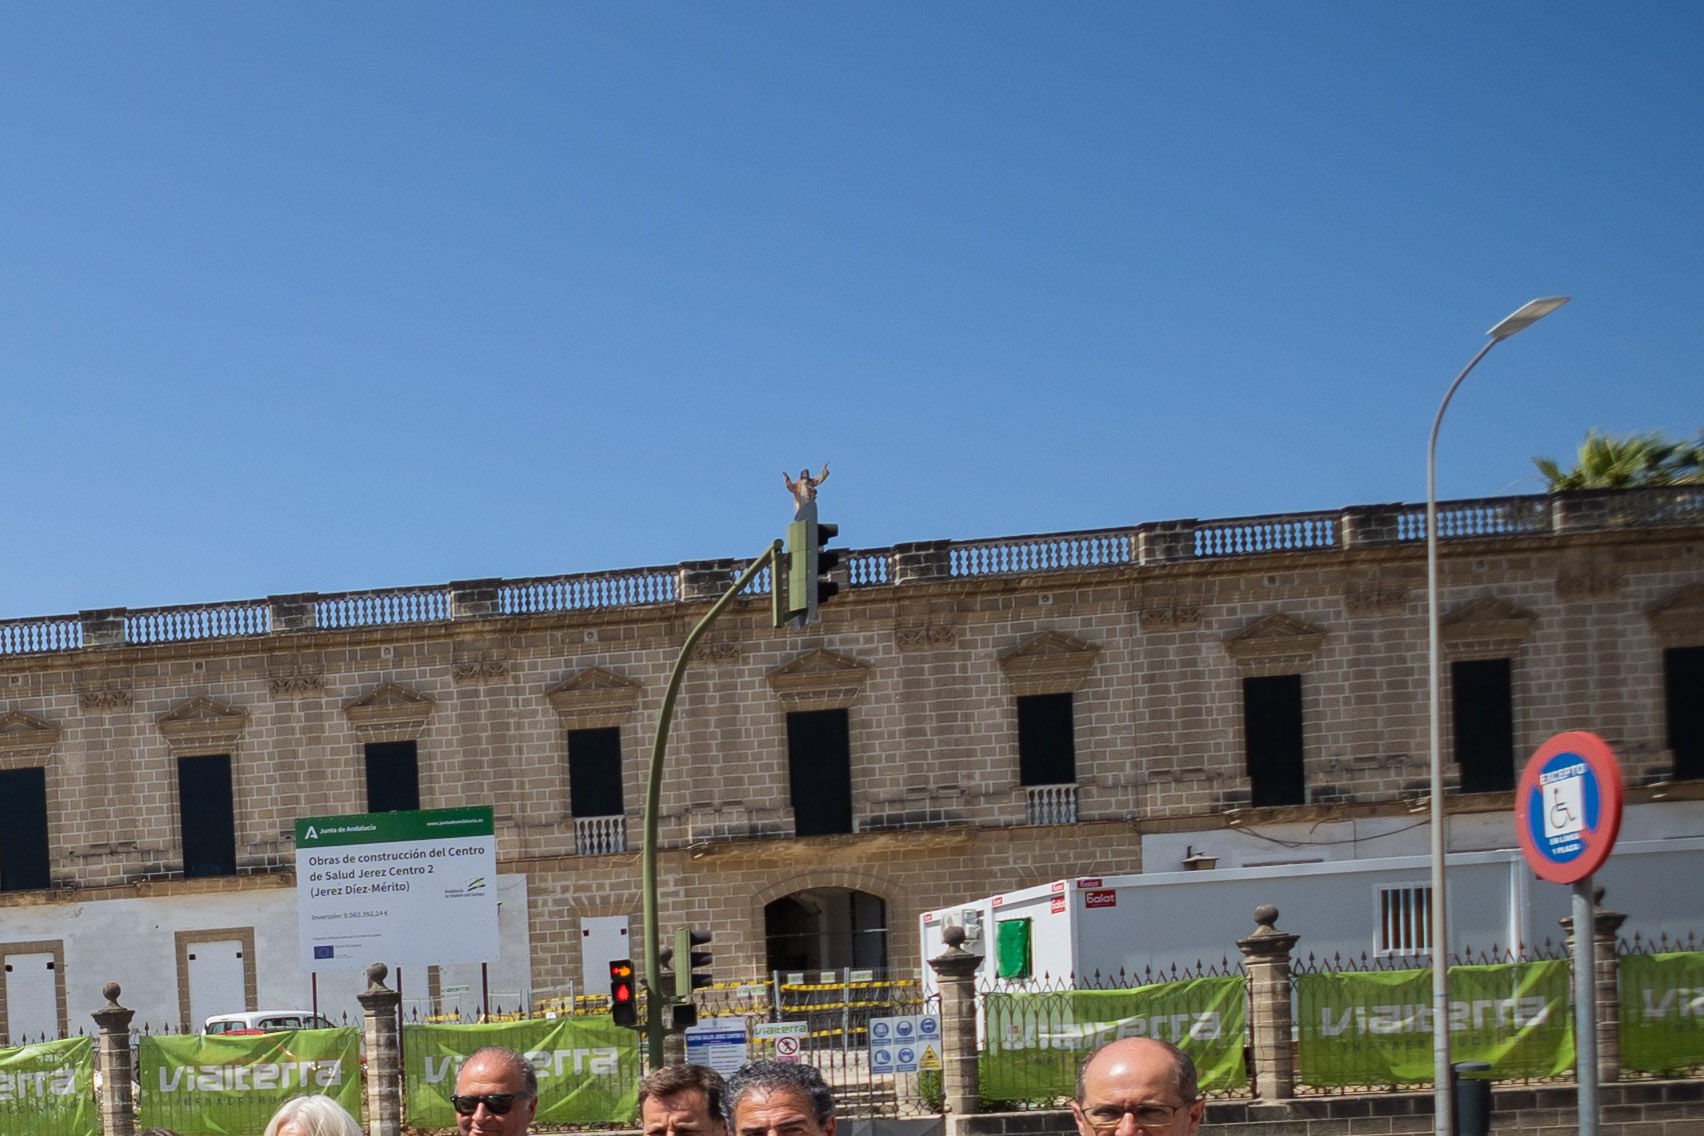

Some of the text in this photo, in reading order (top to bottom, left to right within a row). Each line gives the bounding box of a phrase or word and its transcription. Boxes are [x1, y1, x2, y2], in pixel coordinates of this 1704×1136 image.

[309, 846, 485, 866] Obras de construcción del Centro
[309, 864, 434, 881] de Salud Jerez Centro 2
[310, 880, 410, 899] (Jerez Díez-Mérito)
